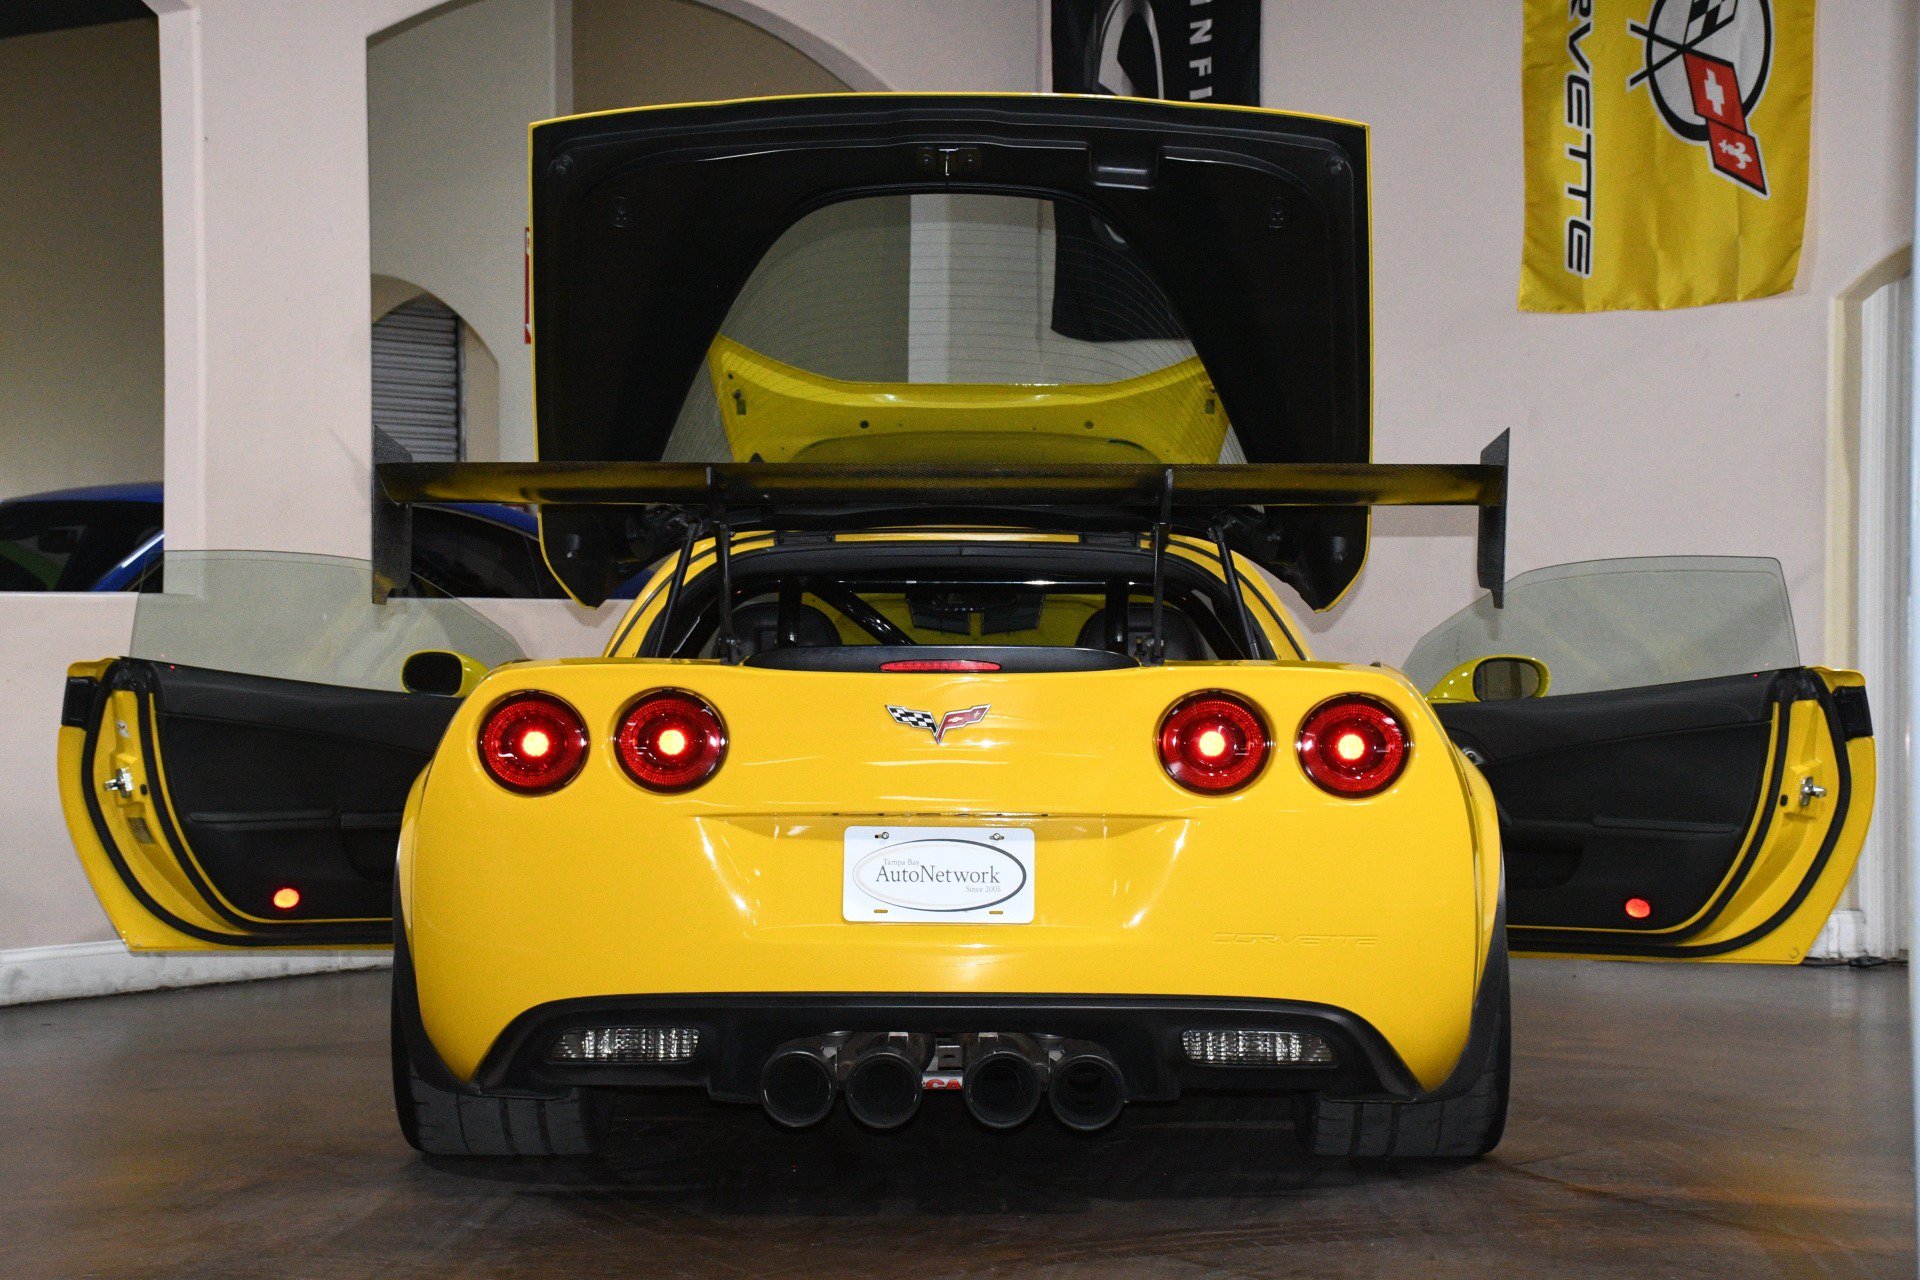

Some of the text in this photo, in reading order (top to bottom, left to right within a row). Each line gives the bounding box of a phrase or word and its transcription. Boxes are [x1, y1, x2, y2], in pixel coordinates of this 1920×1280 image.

[884, 859, 906, 867] Tampa
[875, 865, 1001, 883] AutoNetwork
[1213, 932, 1379, 946] CORVETTE
